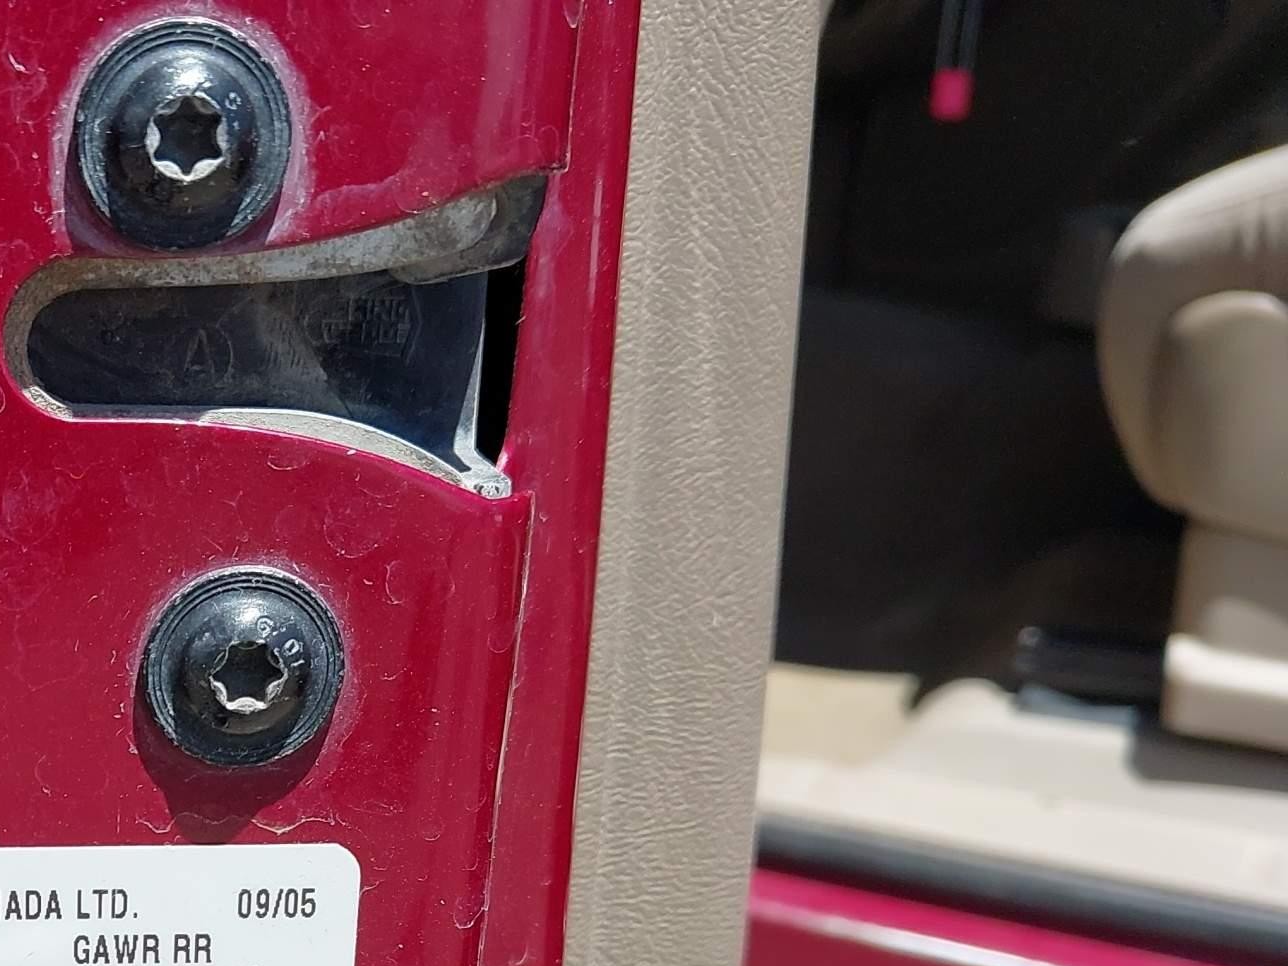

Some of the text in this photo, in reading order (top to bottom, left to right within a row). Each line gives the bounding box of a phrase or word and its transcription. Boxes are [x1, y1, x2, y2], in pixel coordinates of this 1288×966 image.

[77, 889, 137, 919] LTD.
[238, 888, 316, 919] 09/05
[74, 934, 211, 964] GAWR RR
